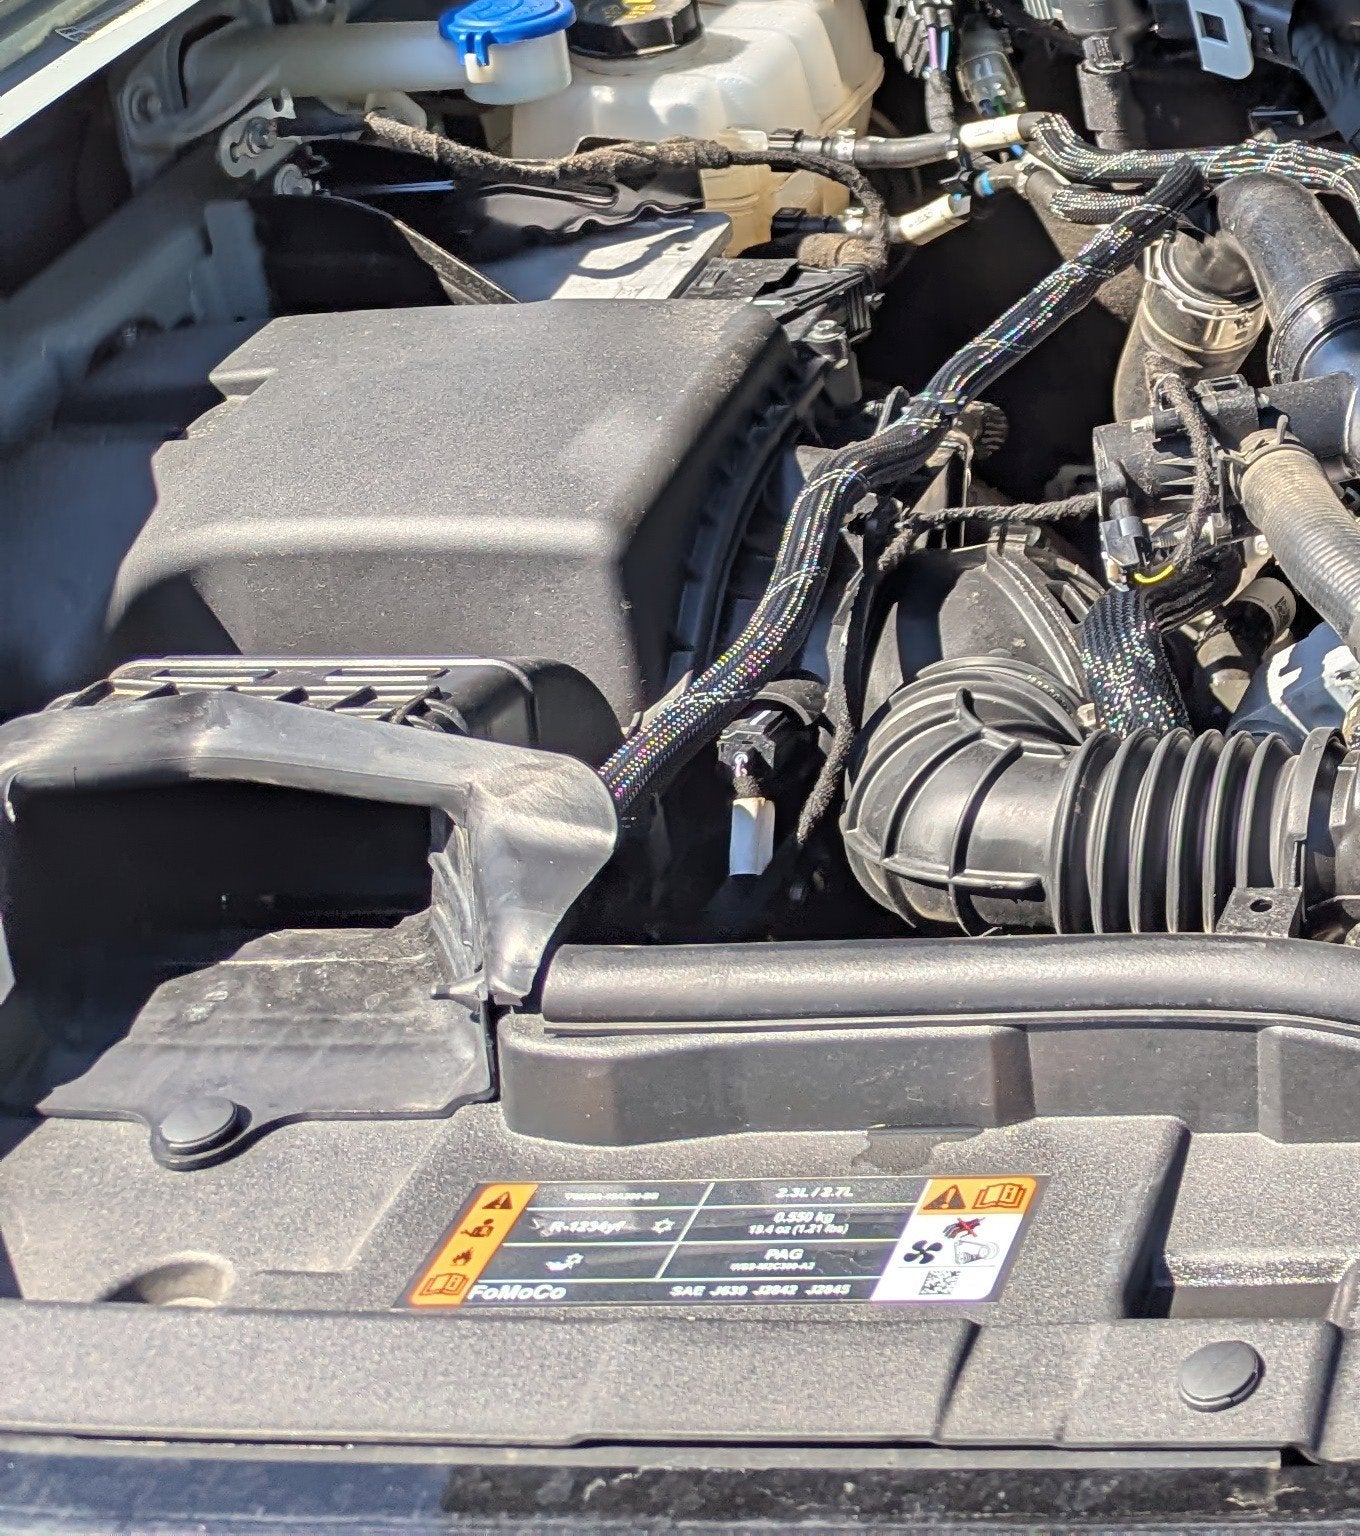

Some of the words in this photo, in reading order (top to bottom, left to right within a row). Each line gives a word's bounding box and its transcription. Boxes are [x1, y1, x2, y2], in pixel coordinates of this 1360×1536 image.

[774, 1186, 809, 1198] 2.3L
[820, 1186, 854, 1198] 2.7L
[763, 1248, 805, 1261] PAG
[466, 1284, 567, 1300] FoMoCo
[668, 1284, 707, 1297] SAE
